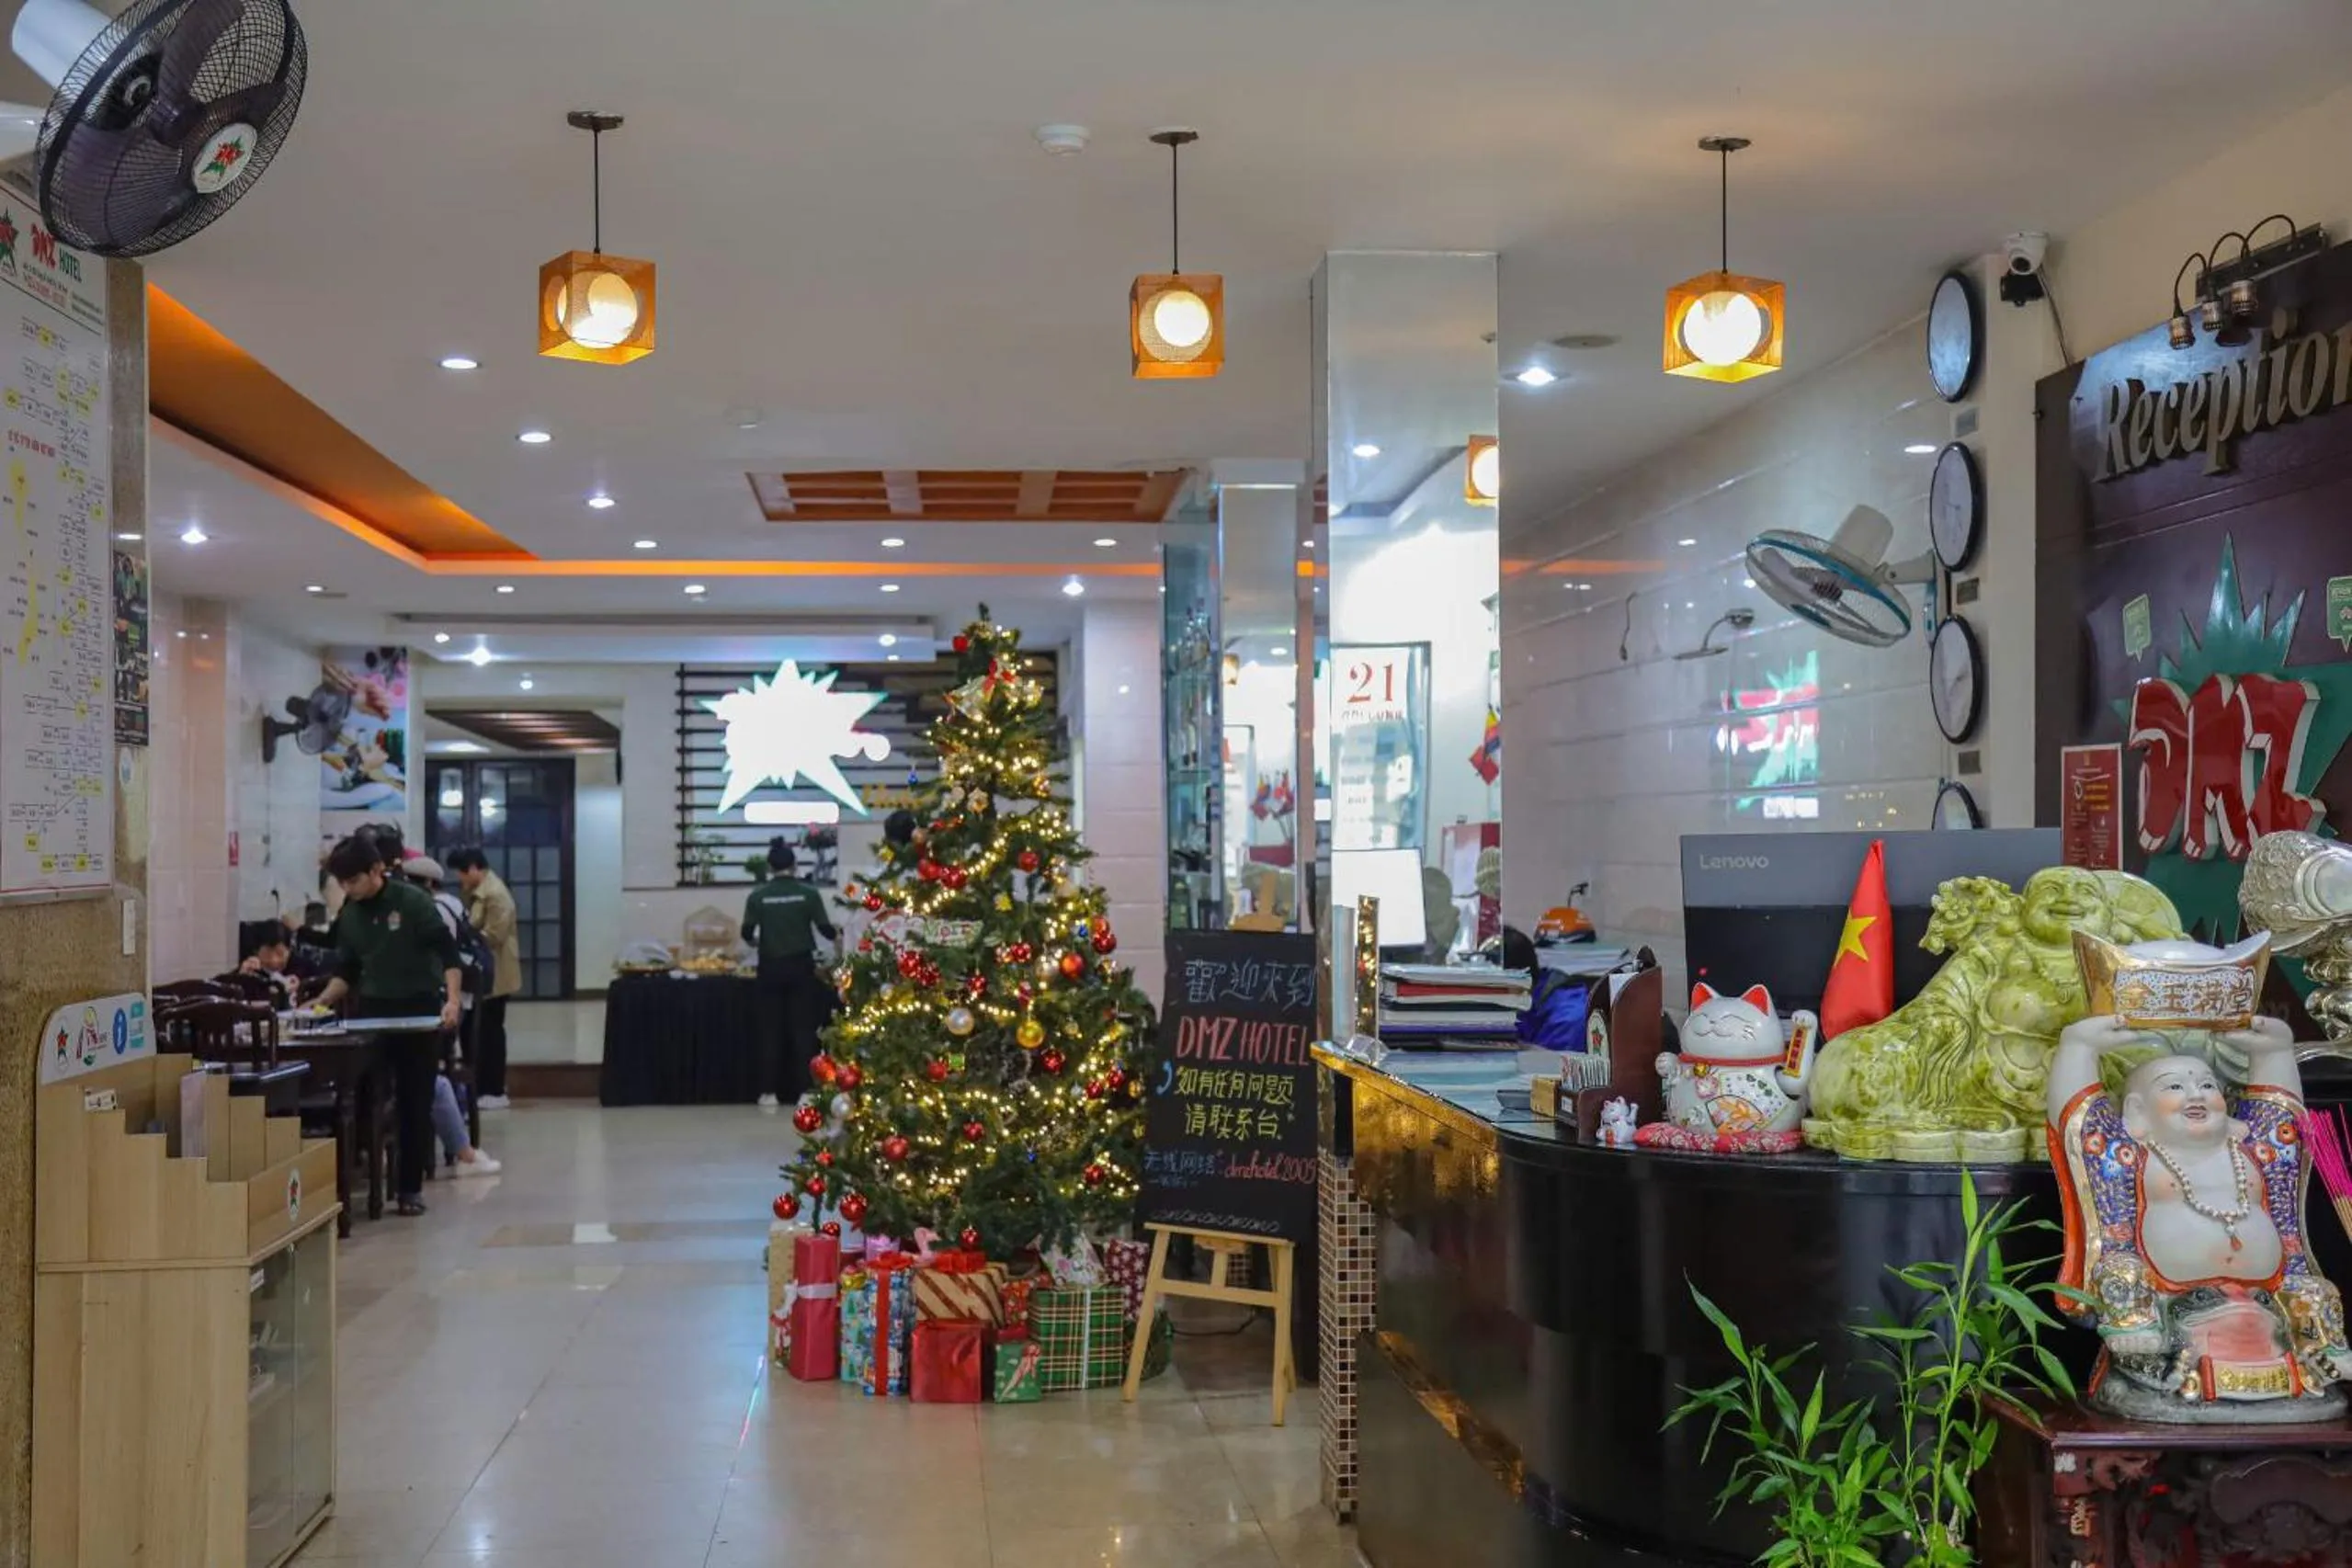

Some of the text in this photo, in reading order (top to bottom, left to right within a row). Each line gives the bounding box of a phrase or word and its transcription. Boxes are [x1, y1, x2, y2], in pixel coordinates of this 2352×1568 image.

[59, 245, 82, 283] HOTEL
[1346, 662, 1394, 703] 21
[1699, 853, 1770, 870] Lenovo
[1176, 1015, 1310, 1066] DMZ HOTEL
